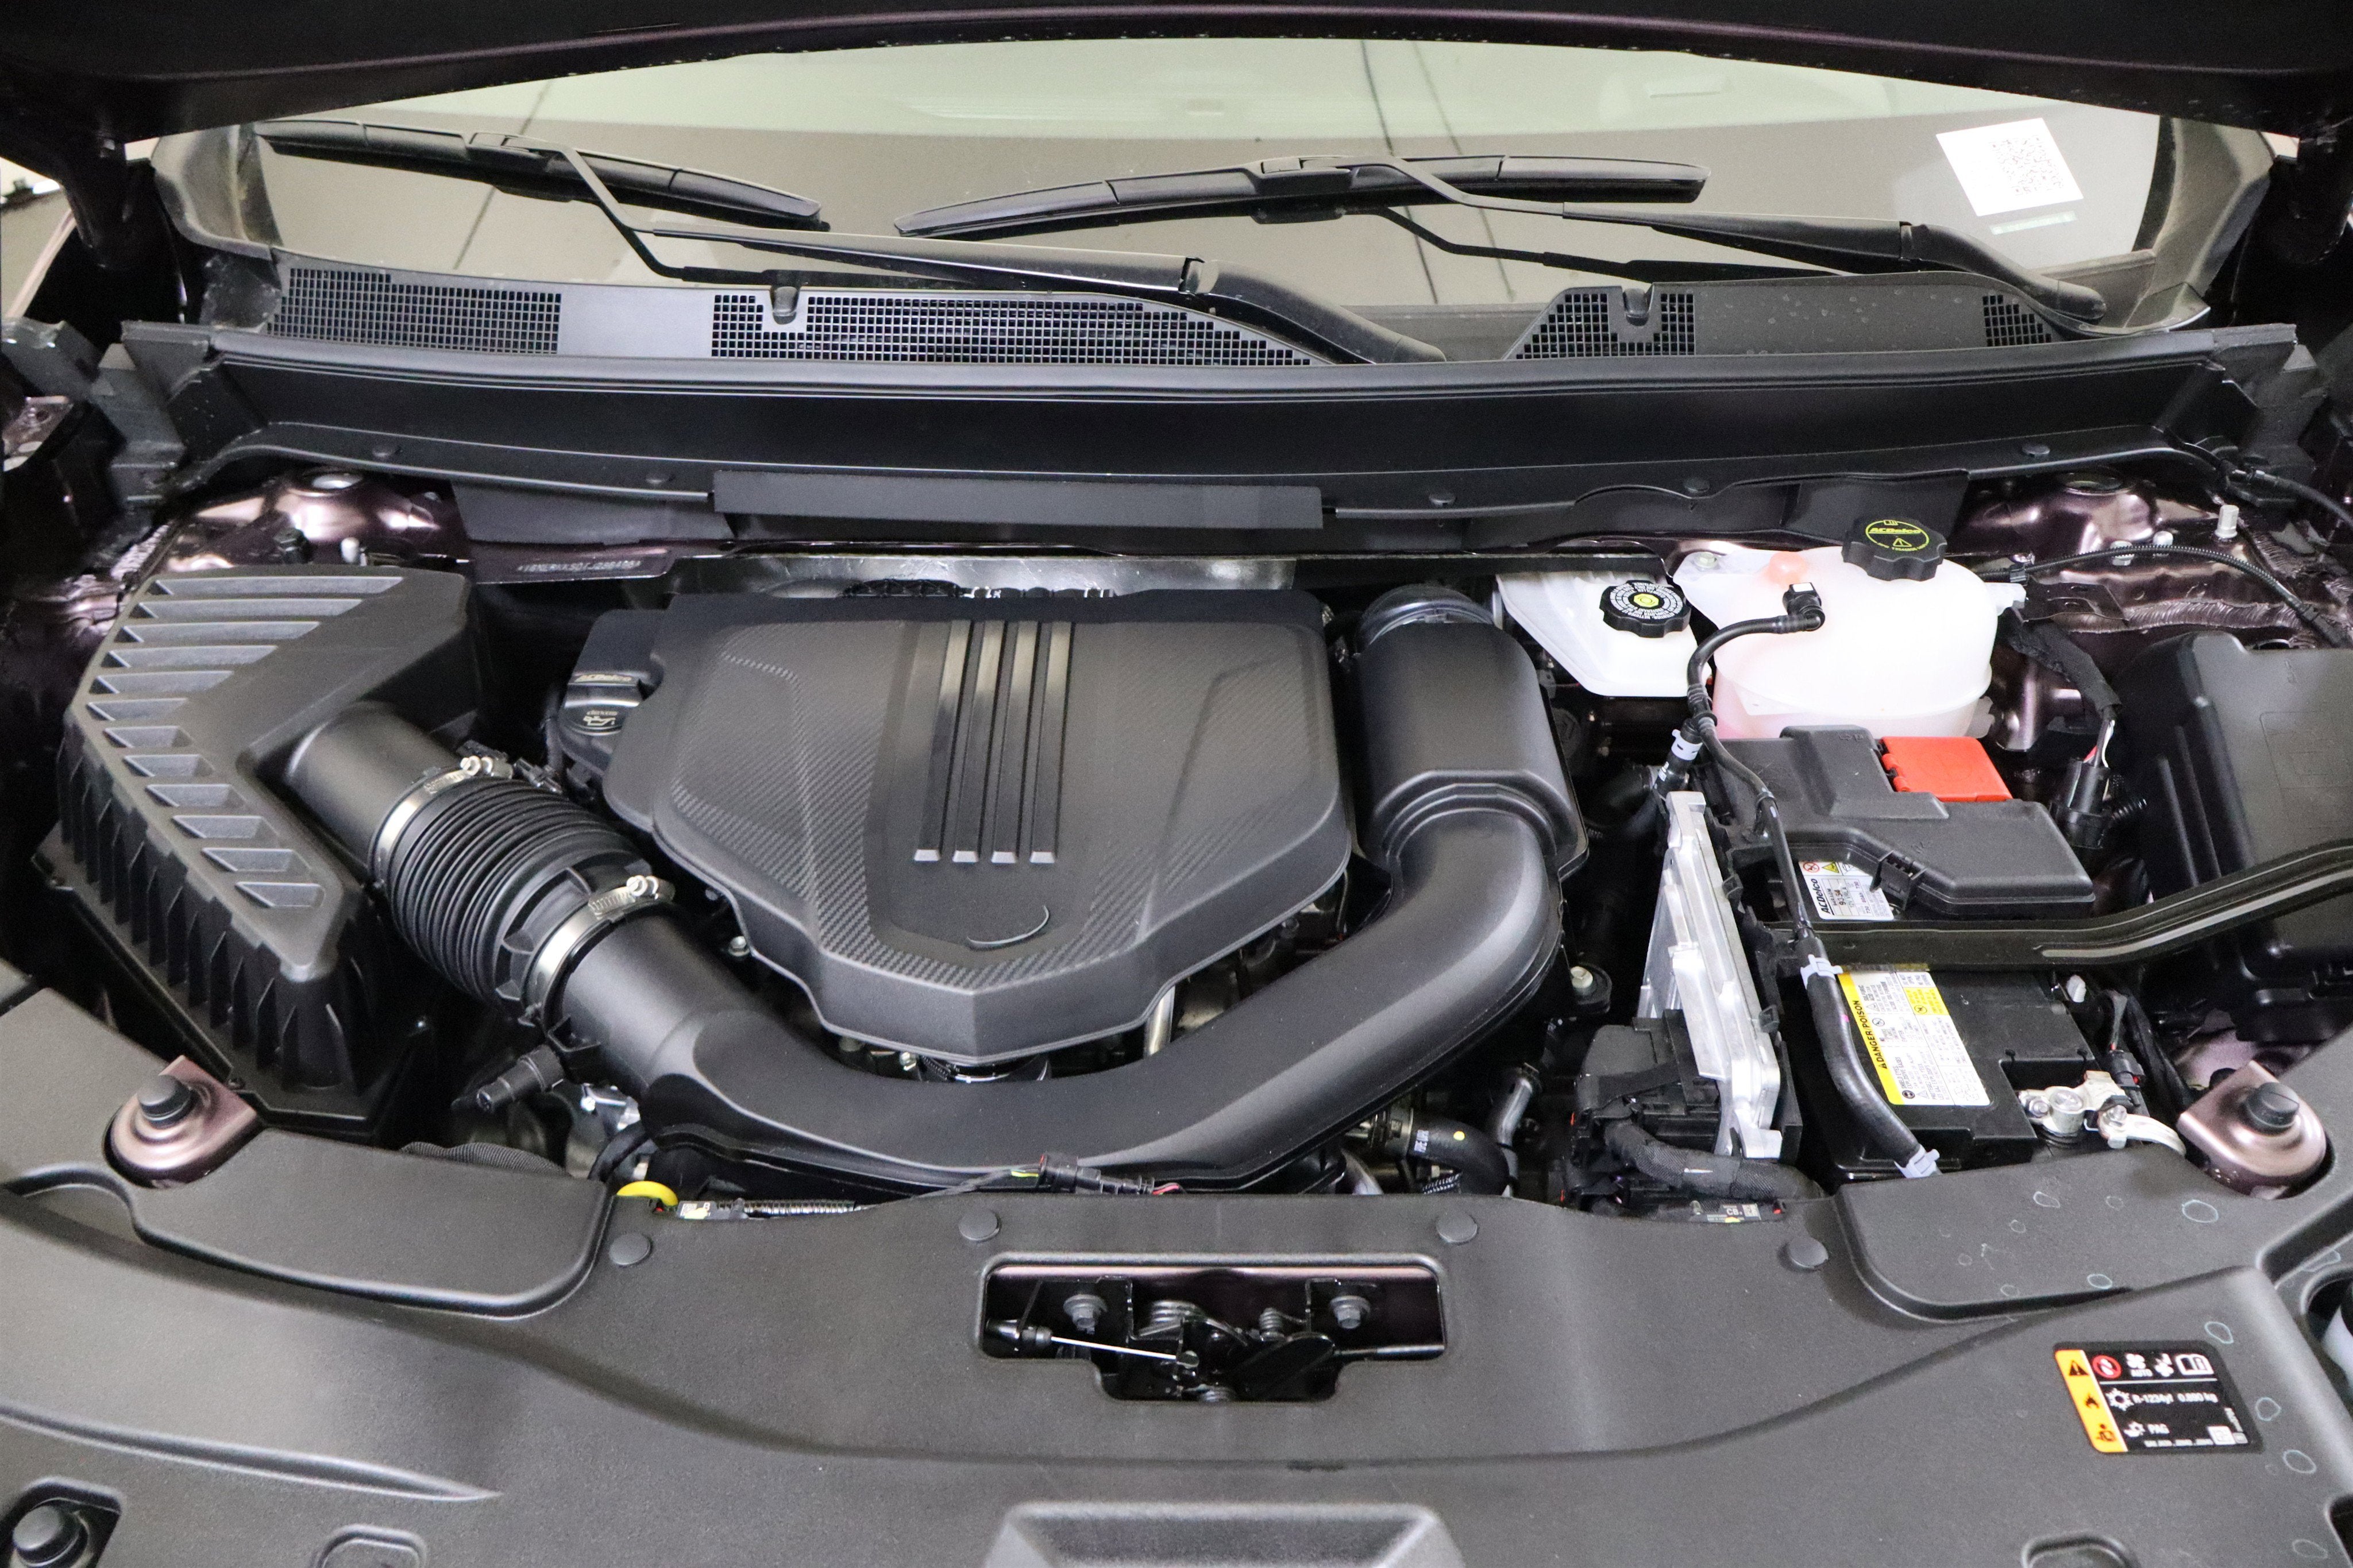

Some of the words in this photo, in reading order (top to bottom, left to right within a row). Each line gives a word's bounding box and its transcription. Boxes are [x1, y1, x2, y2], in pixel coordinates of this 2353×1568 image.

[1811, 878, 1830, 913] ACDelco
[1852, 1000, 1884, 1061] DANGER/POISON
[2131, 1368, 2153, 1377] AUTO
[2204, 1392, 2219, 1404] kg
[2147, 1423, 2170, 1434] PAG
